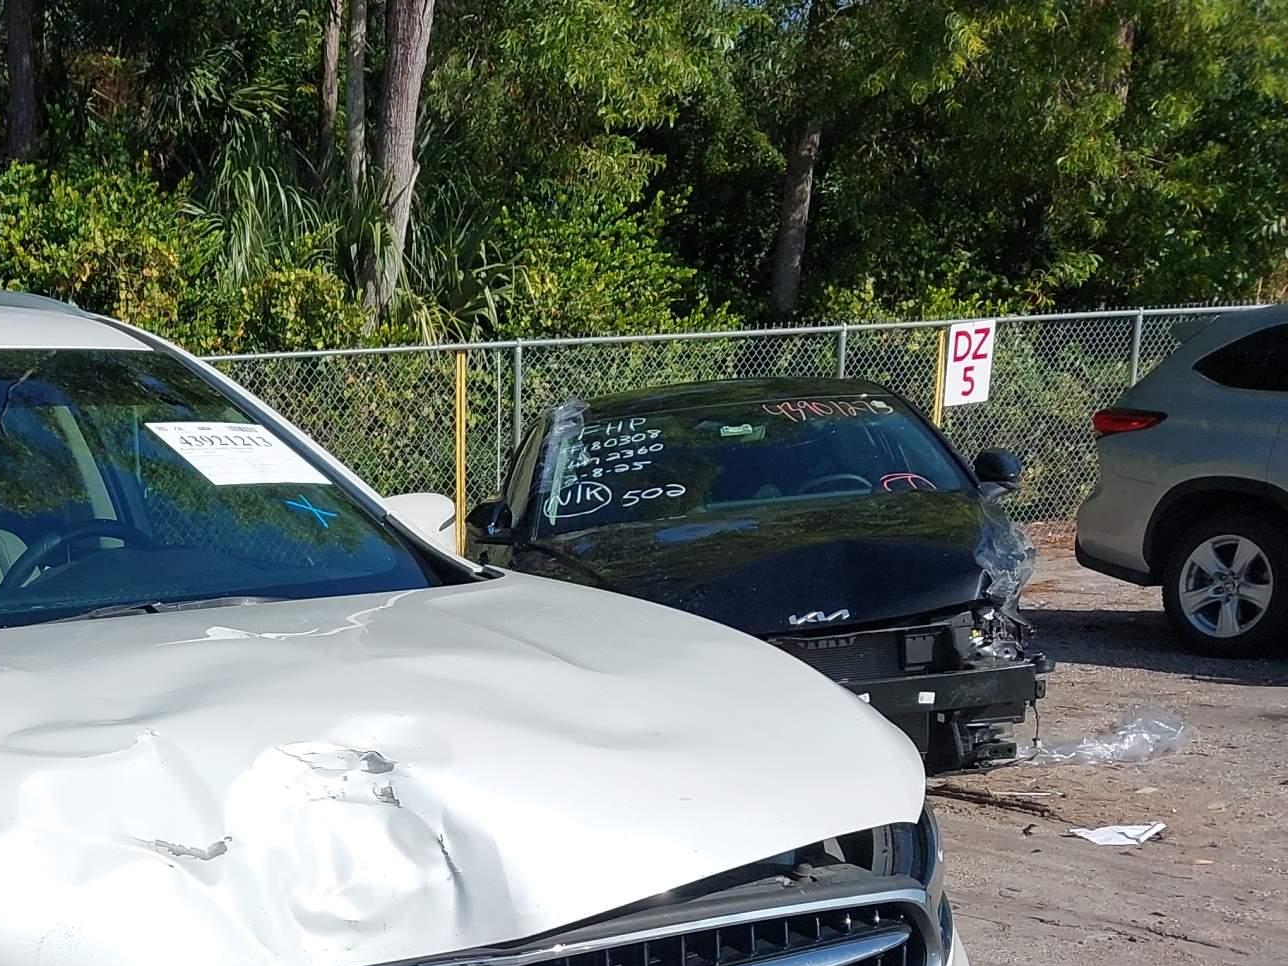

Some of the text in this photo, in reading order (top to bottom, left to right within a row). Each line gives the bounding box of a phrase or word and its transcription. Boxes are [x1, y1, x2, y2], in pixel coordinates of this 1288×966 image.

[952, 327, 991, 363] DZ
[960, 365, 975, 397] 5
[577, 417, 647, 441] FHP
[179, 435, 273, 448] 43921213
[622, 483, 687, 508] 502
[788, 608, 851, 625] KIA
